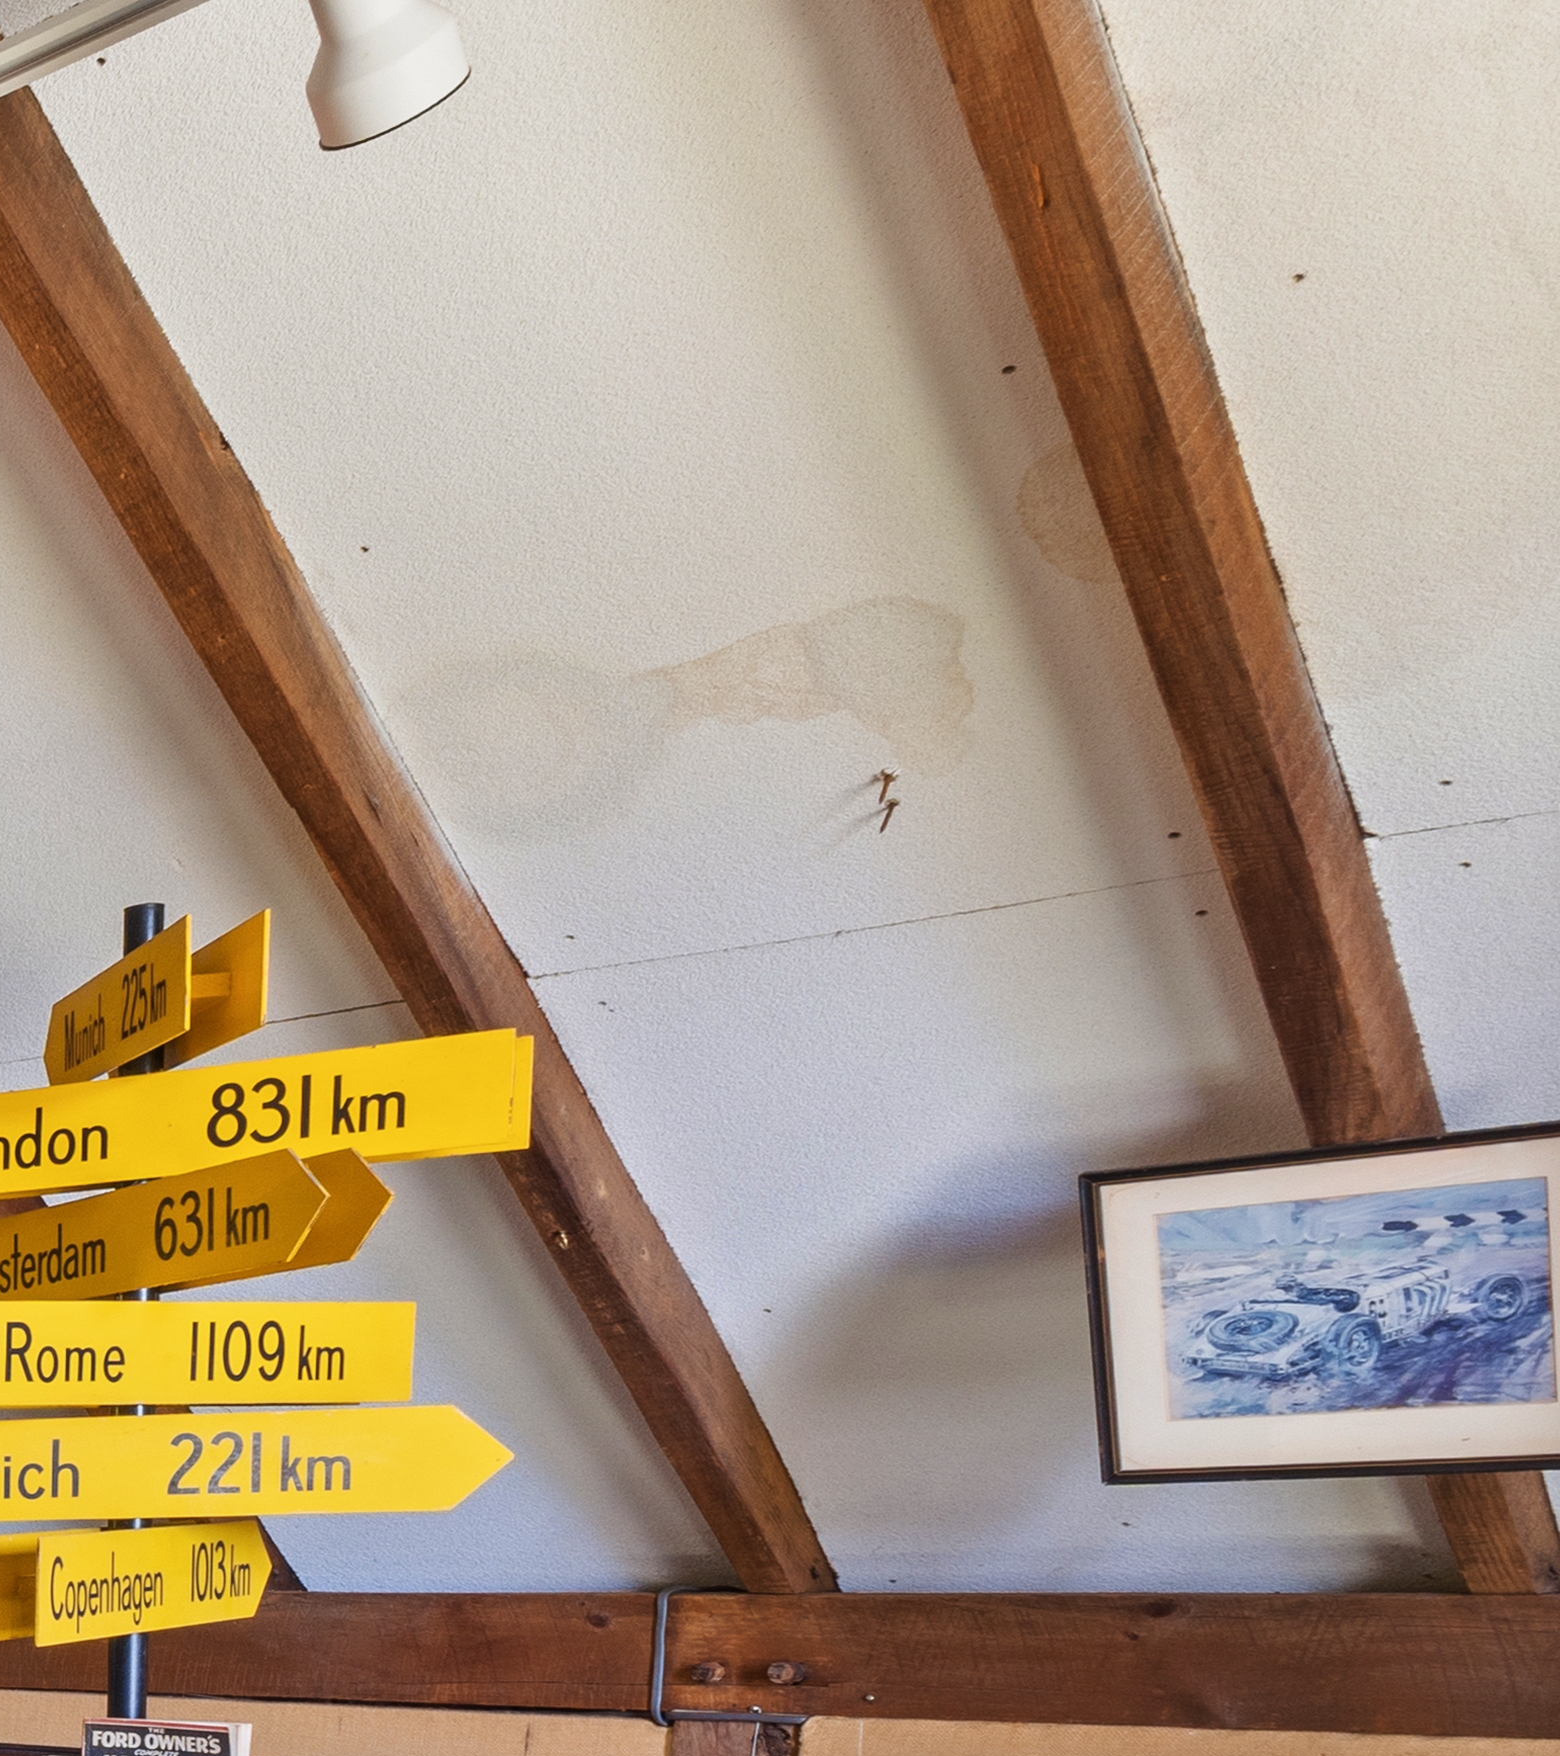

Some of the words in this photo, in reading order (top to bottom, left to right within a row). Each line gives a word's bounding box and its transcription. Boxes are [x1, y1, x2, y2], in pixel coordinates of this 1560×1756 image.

[64, 1012, 106, 1071] Munich
[120, 970, 148, 1041] 225
[149, 974, 168, 1021] km
[206, 1075, 310, 1149] 831
[332, 1076, 407, 1136] km
[153, 1190, 215, 1262] 631
[226, 1190, 270, 1245] km
[4, 1322, 126, 1383] Rome
[189, 1320, 286, 1383] 1109
[298, 1326, 346, 1383] km
[167, 1431, 264, 1496] 221
[281, 1436, 352, 1494] km
[49, 1556, 165, 1634] Copenhagen
[190, 1540, 227, 1603] 1013
[229, 1545, 252, 1598] km
[91, 1730, 142, 1749] FORD
[144, 1734, 222, 1755] OWNER'S
